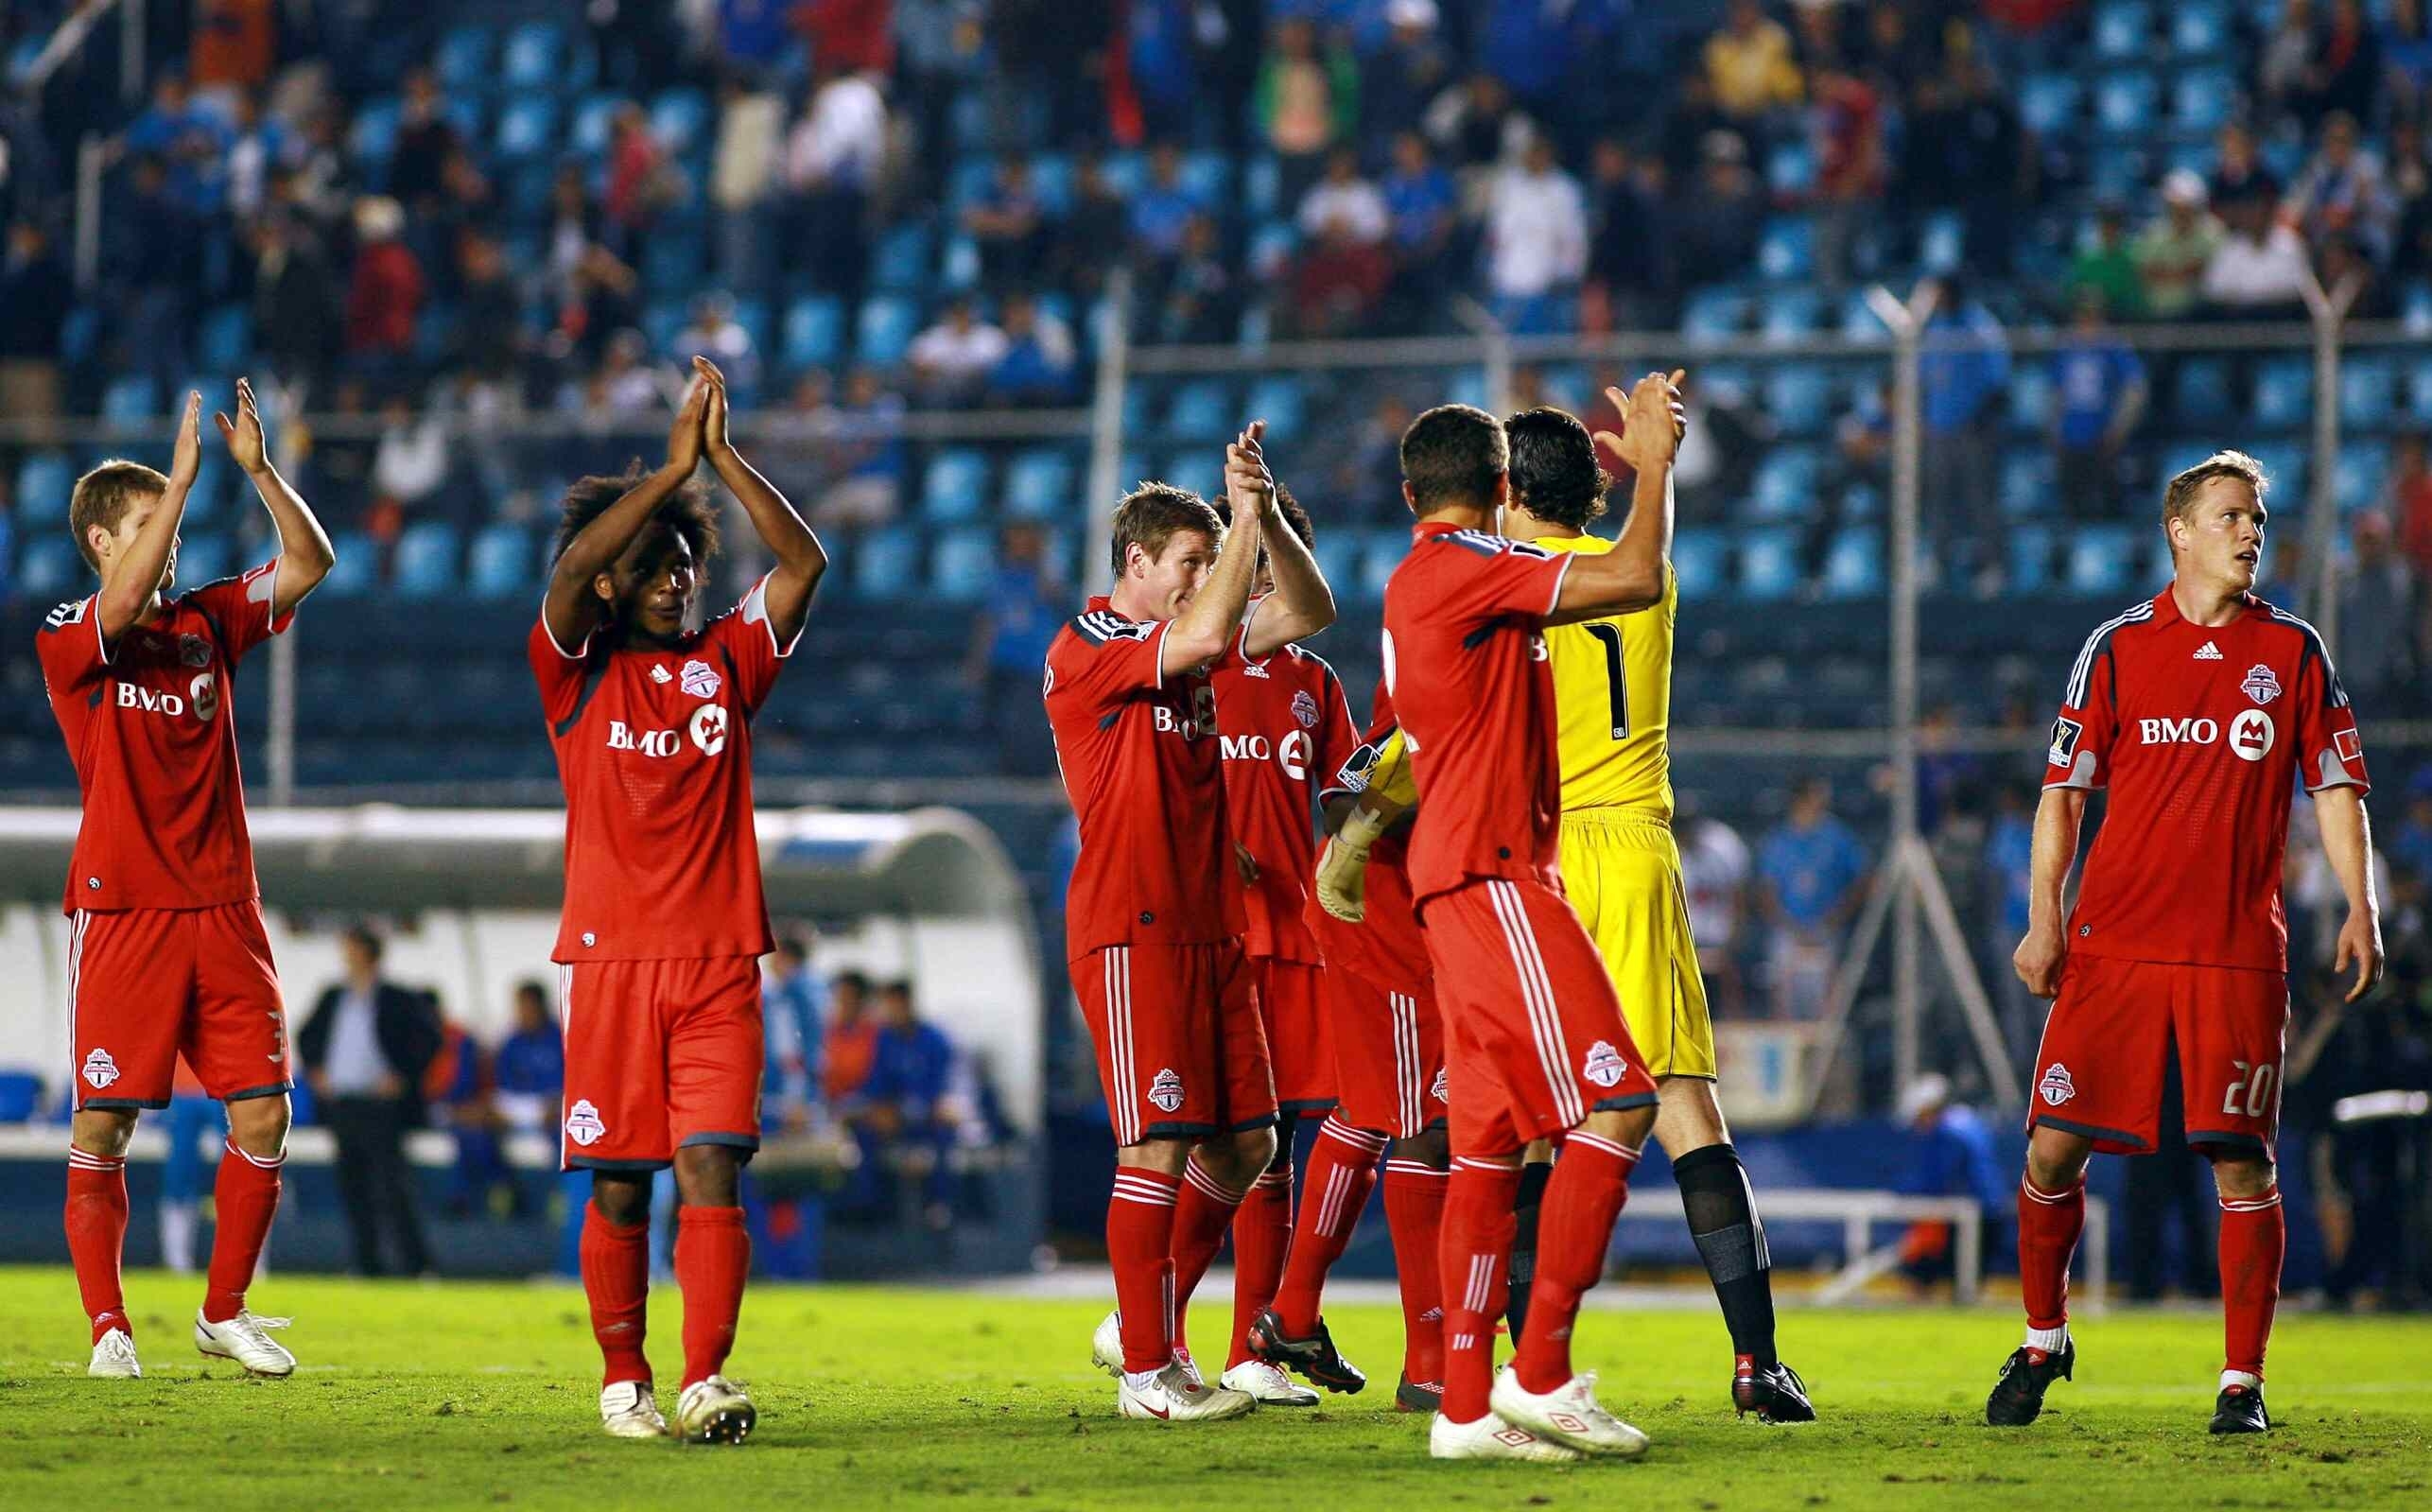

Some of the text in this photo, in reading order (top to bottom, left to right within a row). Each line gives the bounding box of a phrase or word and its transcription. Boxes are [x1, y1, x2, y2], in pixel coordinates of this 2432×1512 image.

[1153, 705, 1199, 741] BO
[2139, 718, 2217, 744] BMO
[1219, 735, 1271, 760] MO
[2223, 1060, 2273, 1117] 20
